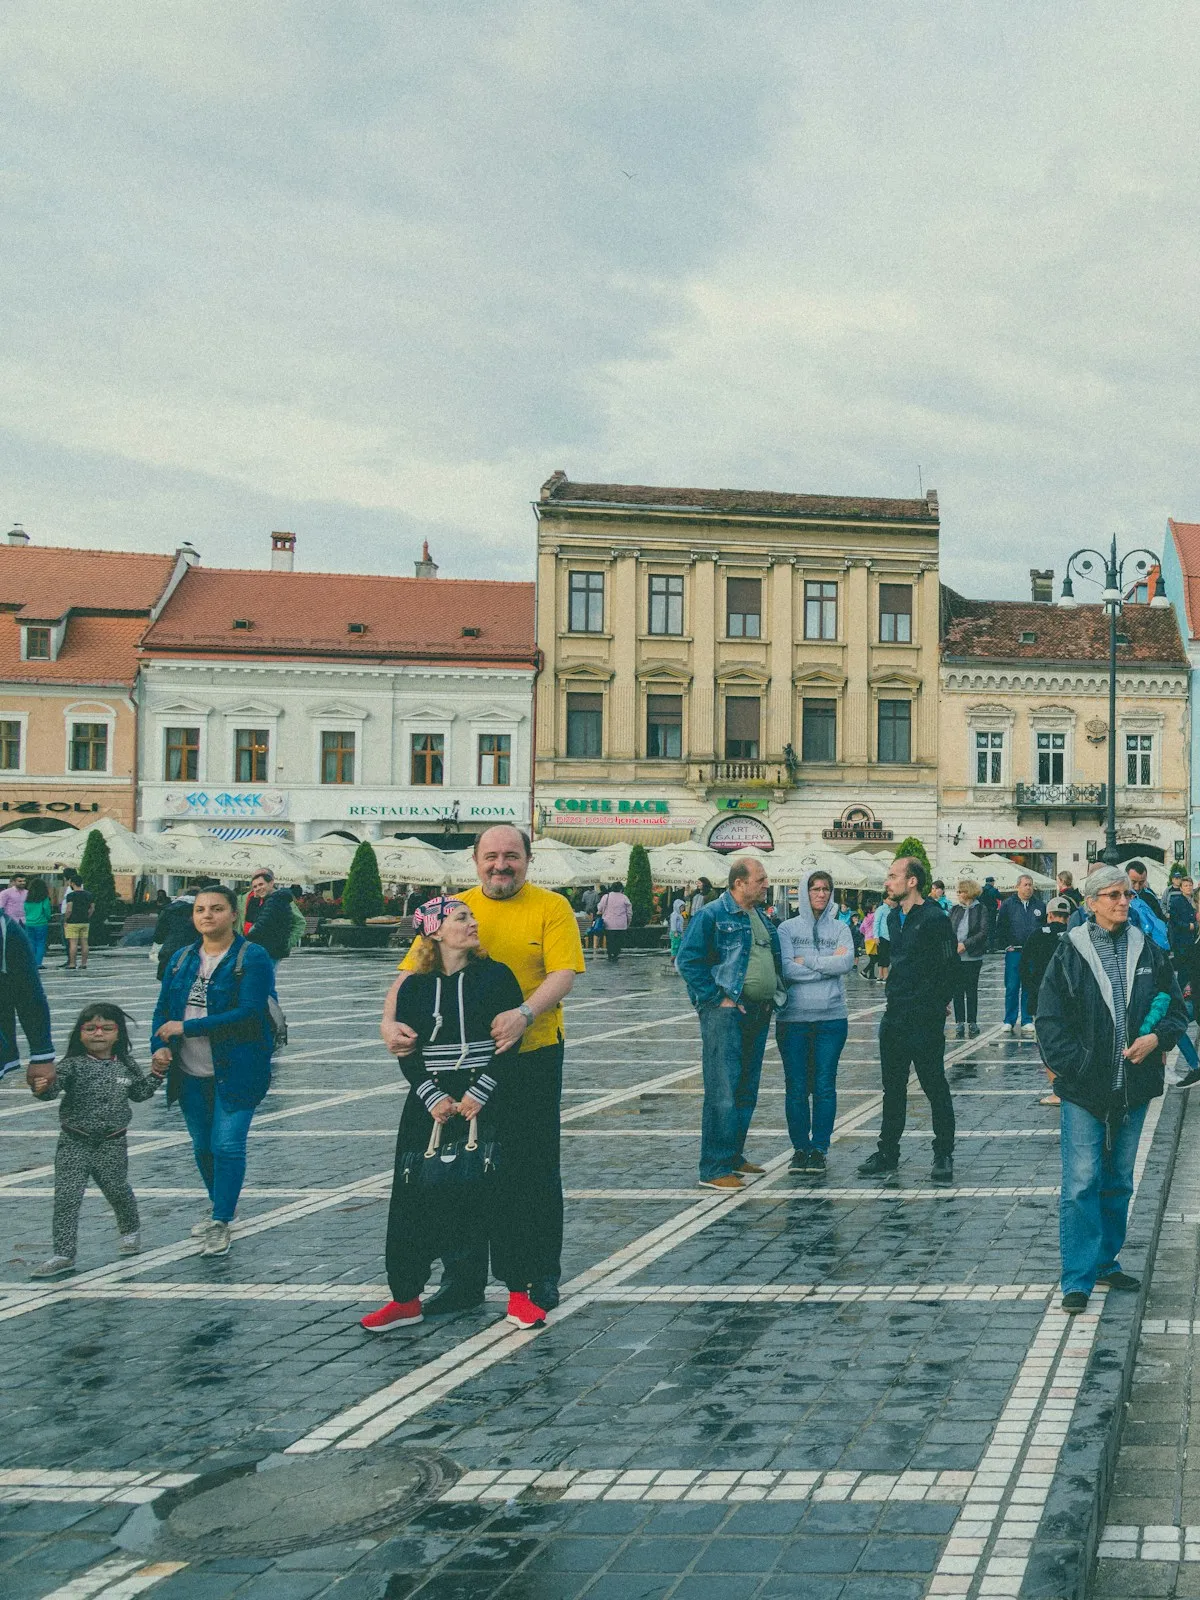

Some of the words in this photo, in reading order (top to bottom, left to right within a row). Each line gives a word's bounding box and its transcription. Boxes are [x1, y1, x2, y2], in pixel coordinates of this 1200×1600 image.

[186, 791, 208, 808] GO
[215, 792, 263, 808] GREEK
[350, 806, 450, 816] RESTAURANT
[470, 807, 516, 816] ROMA
[618, 800, 670, 814] BACK
[978, 836, 1043, 849] inmedio
